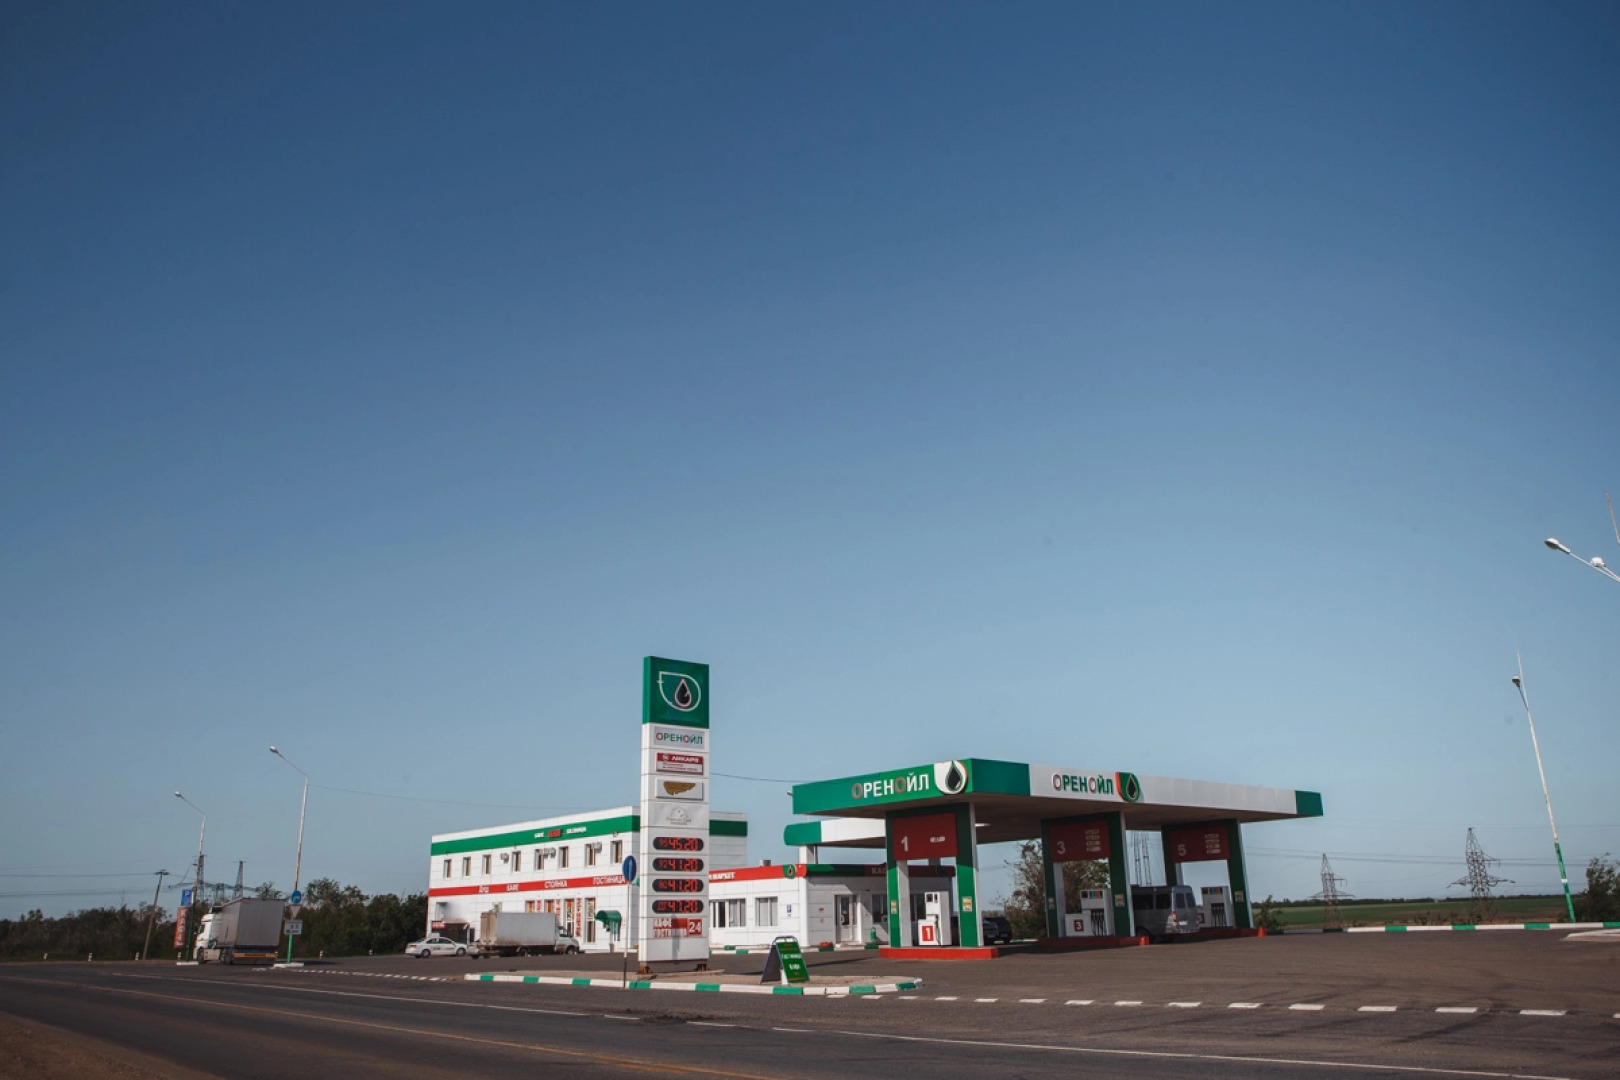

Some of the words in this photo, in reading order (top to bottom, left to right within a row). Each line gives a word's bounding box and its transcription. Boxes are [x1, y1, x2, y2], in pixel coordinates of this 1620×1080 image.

[656, 732, 703, 745] ОРЕНОЙЛ
[852, 772, 930, 800] ОРЕНОЙЛ
[1053, 774, 1114, 795] ОРЕНОЙЛ
[901, 836, 909, 852] 1
[1057, 840, 1066, 855] 3
[1178, 844, 1187, 857] 5
[689, 921, 702, 933] 24
[1075, 921, 1083, 930] 3
[926, 928, 932, 940] 1
